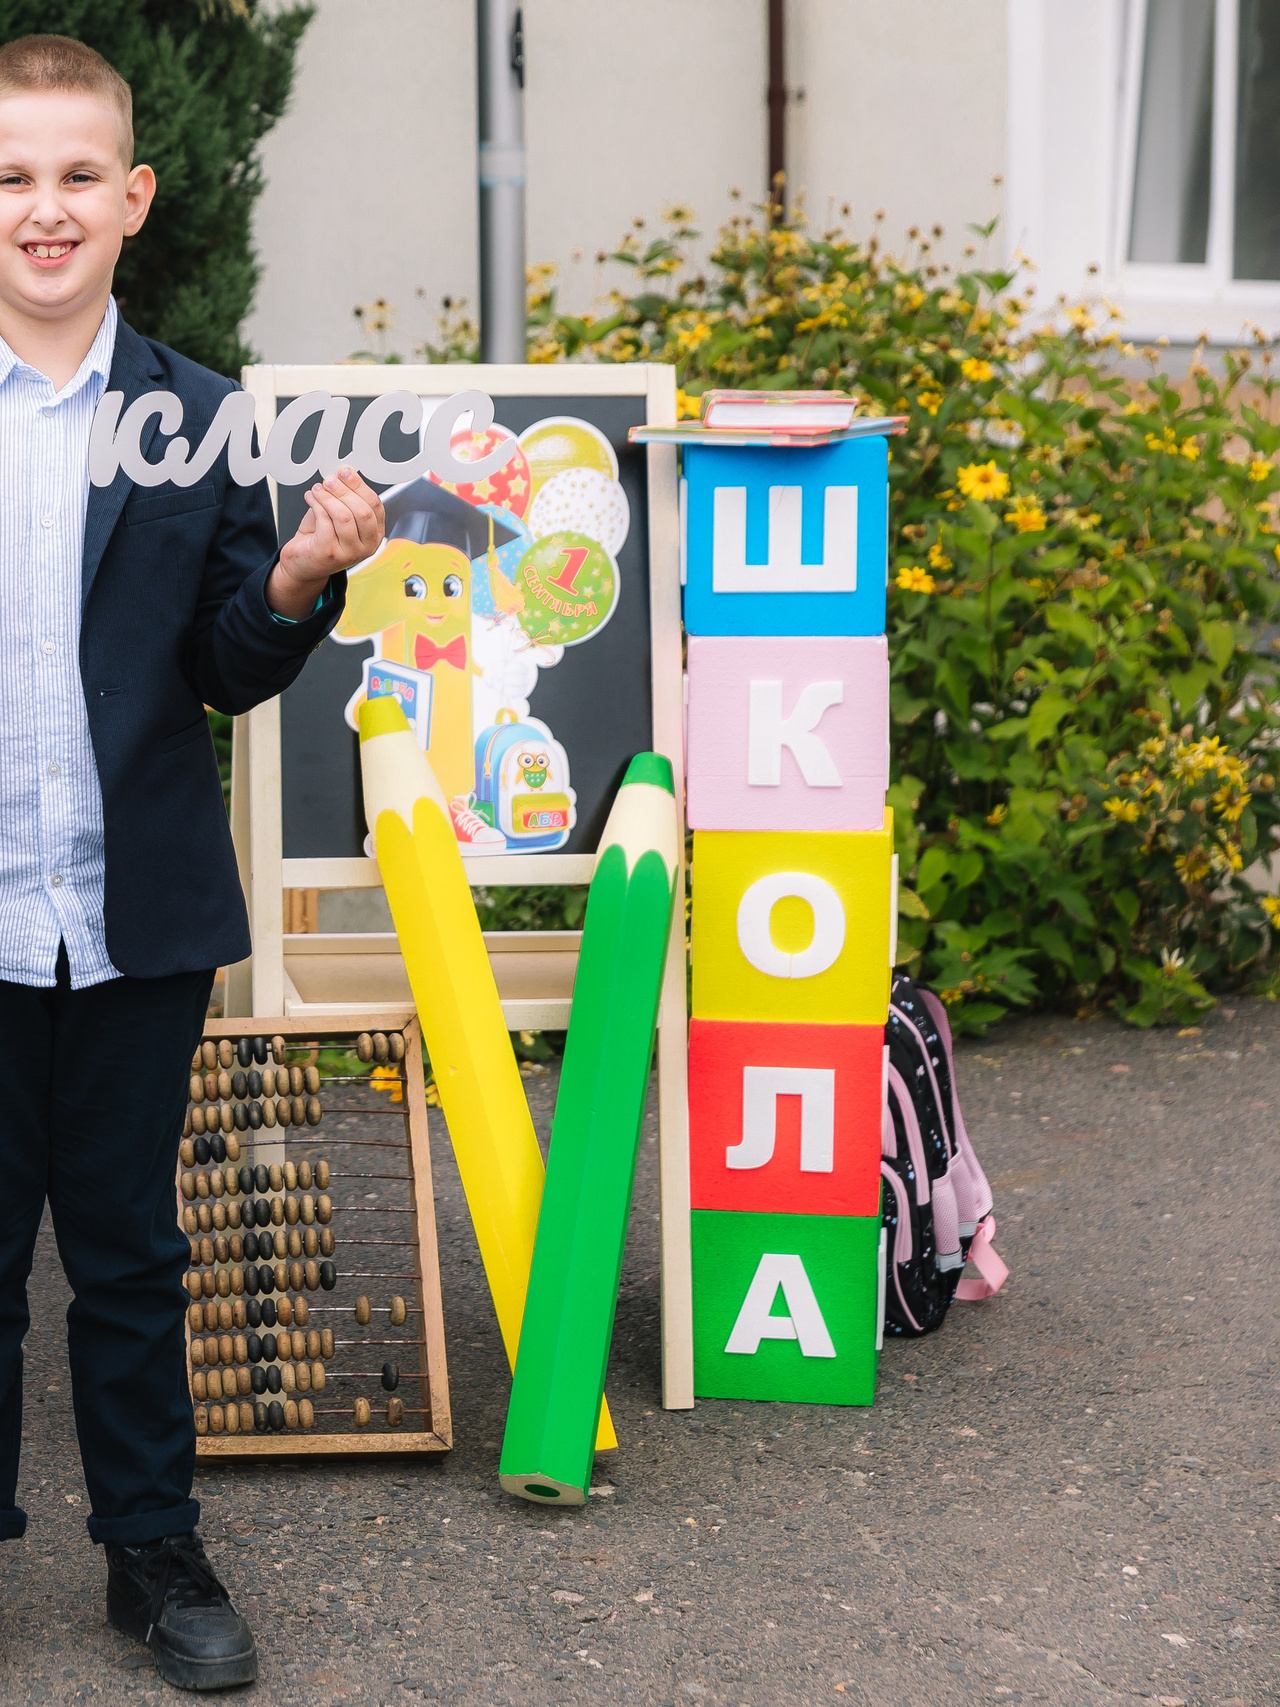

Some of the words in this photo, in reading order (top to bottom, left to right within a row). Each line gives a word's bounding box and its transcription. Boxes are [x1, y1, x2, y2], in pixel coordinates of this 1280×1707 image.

[89, 389, 516, 488] класс
[523, 565, 598, 617] СЕНТЯБРЯ
[546, 546, 590, 597] 1
[527, 812, 564, 829] АБВ
[713, 485, 858, 1358] ШКОЛА
